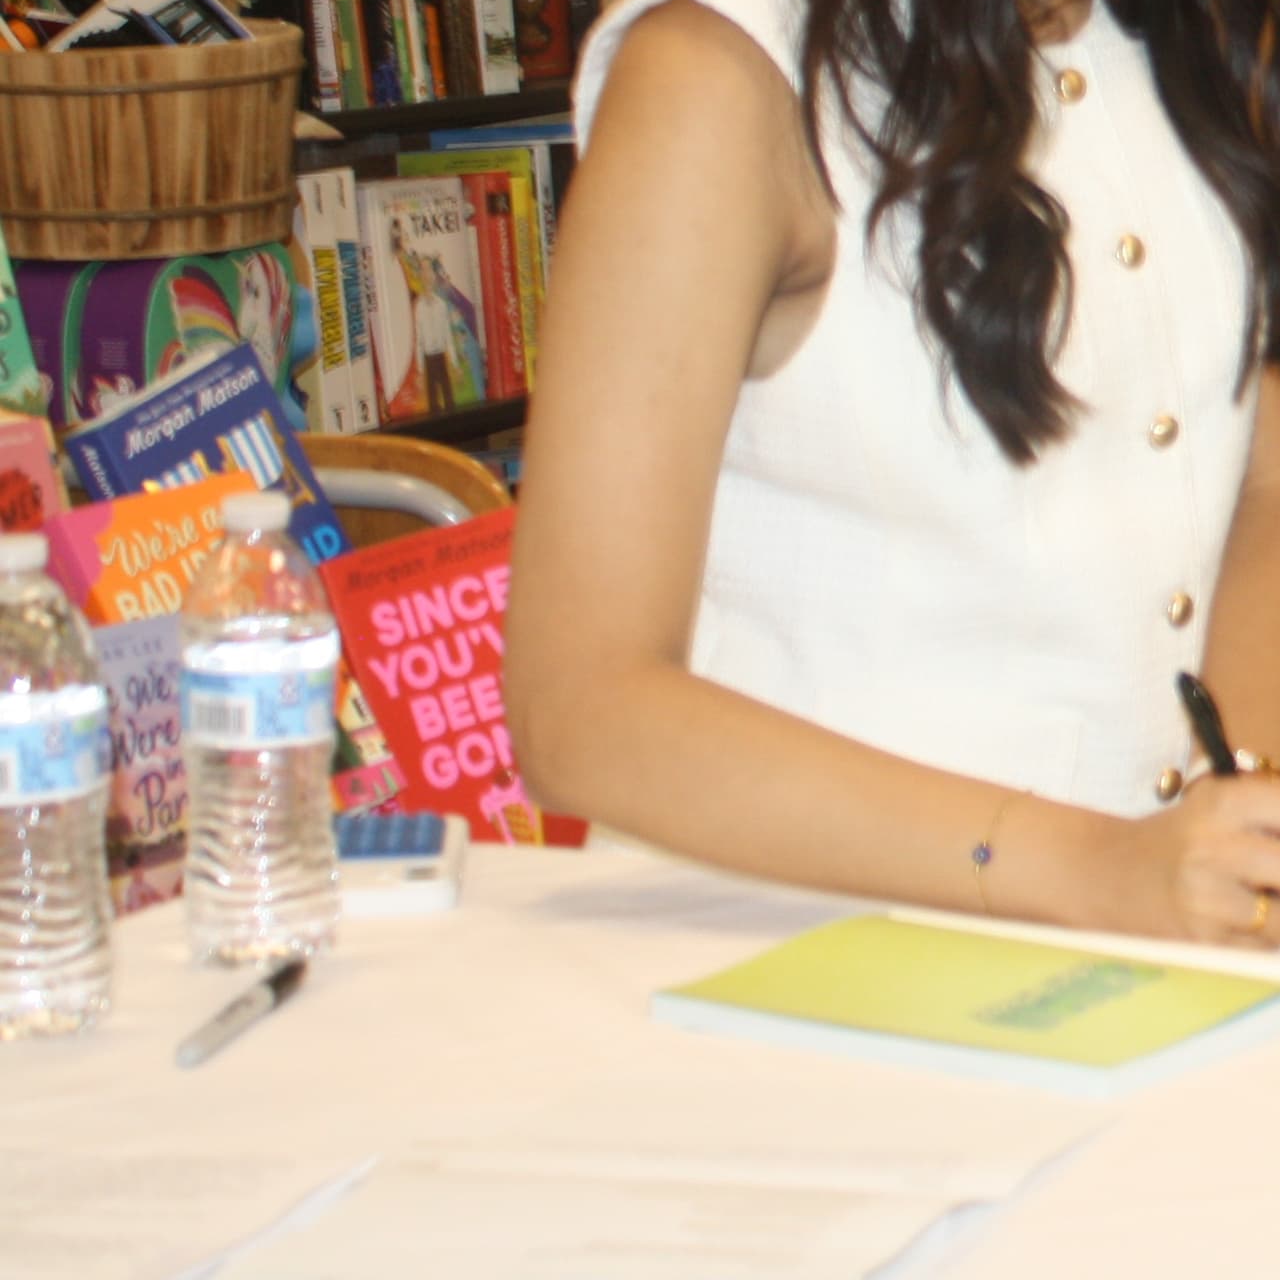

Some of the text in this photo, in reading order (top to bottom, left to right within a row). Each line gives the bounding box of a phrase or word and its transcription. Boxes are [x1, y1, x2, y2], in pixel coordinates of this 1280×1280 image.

[409, 210, 461, 238] TAKEI
[123, 405, 196, 460] Morgan
[196, 365, 260, 418] Matson
[100, 514, 200, 578] We're
[114, 571, 183, 625] BAD
[371, 566, 512, 647] SINCE
